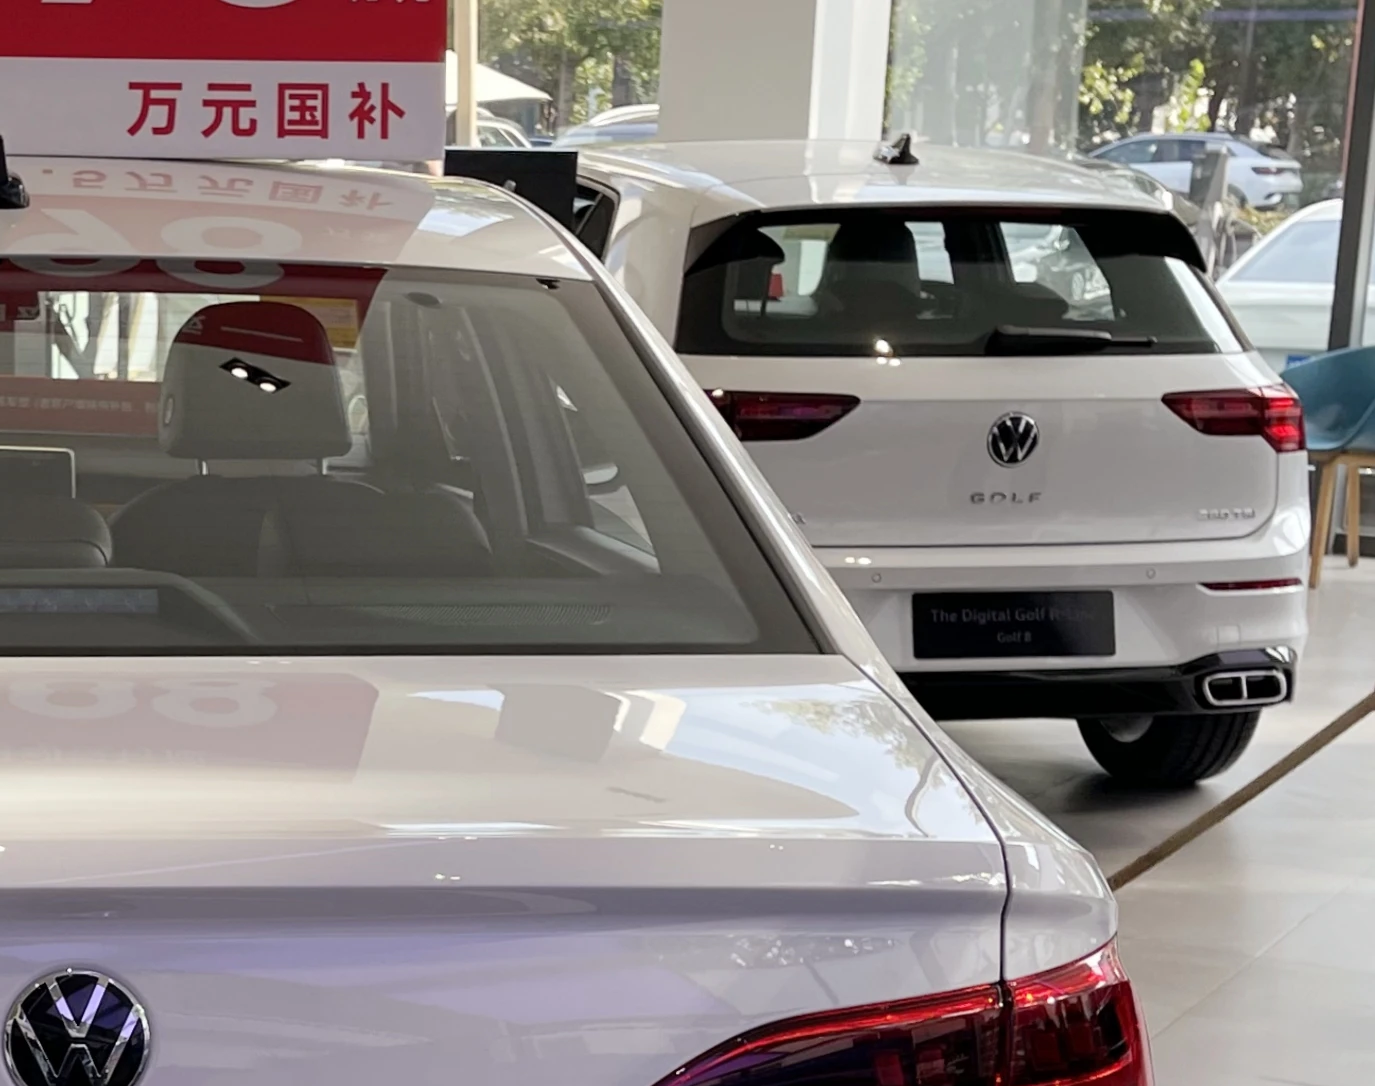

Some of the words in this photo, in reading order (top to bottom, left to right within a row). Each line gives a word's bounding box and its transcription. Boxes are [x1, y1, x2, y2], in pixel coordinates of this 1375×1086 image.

[126, 81, 406, 140] 万元国补
[970, 492, 1042, 505] GOLF
[931, 609, 958, 622] The
[962, 608, 1011, 625] Digital
[1015, 608, 1046, 622] Golf
